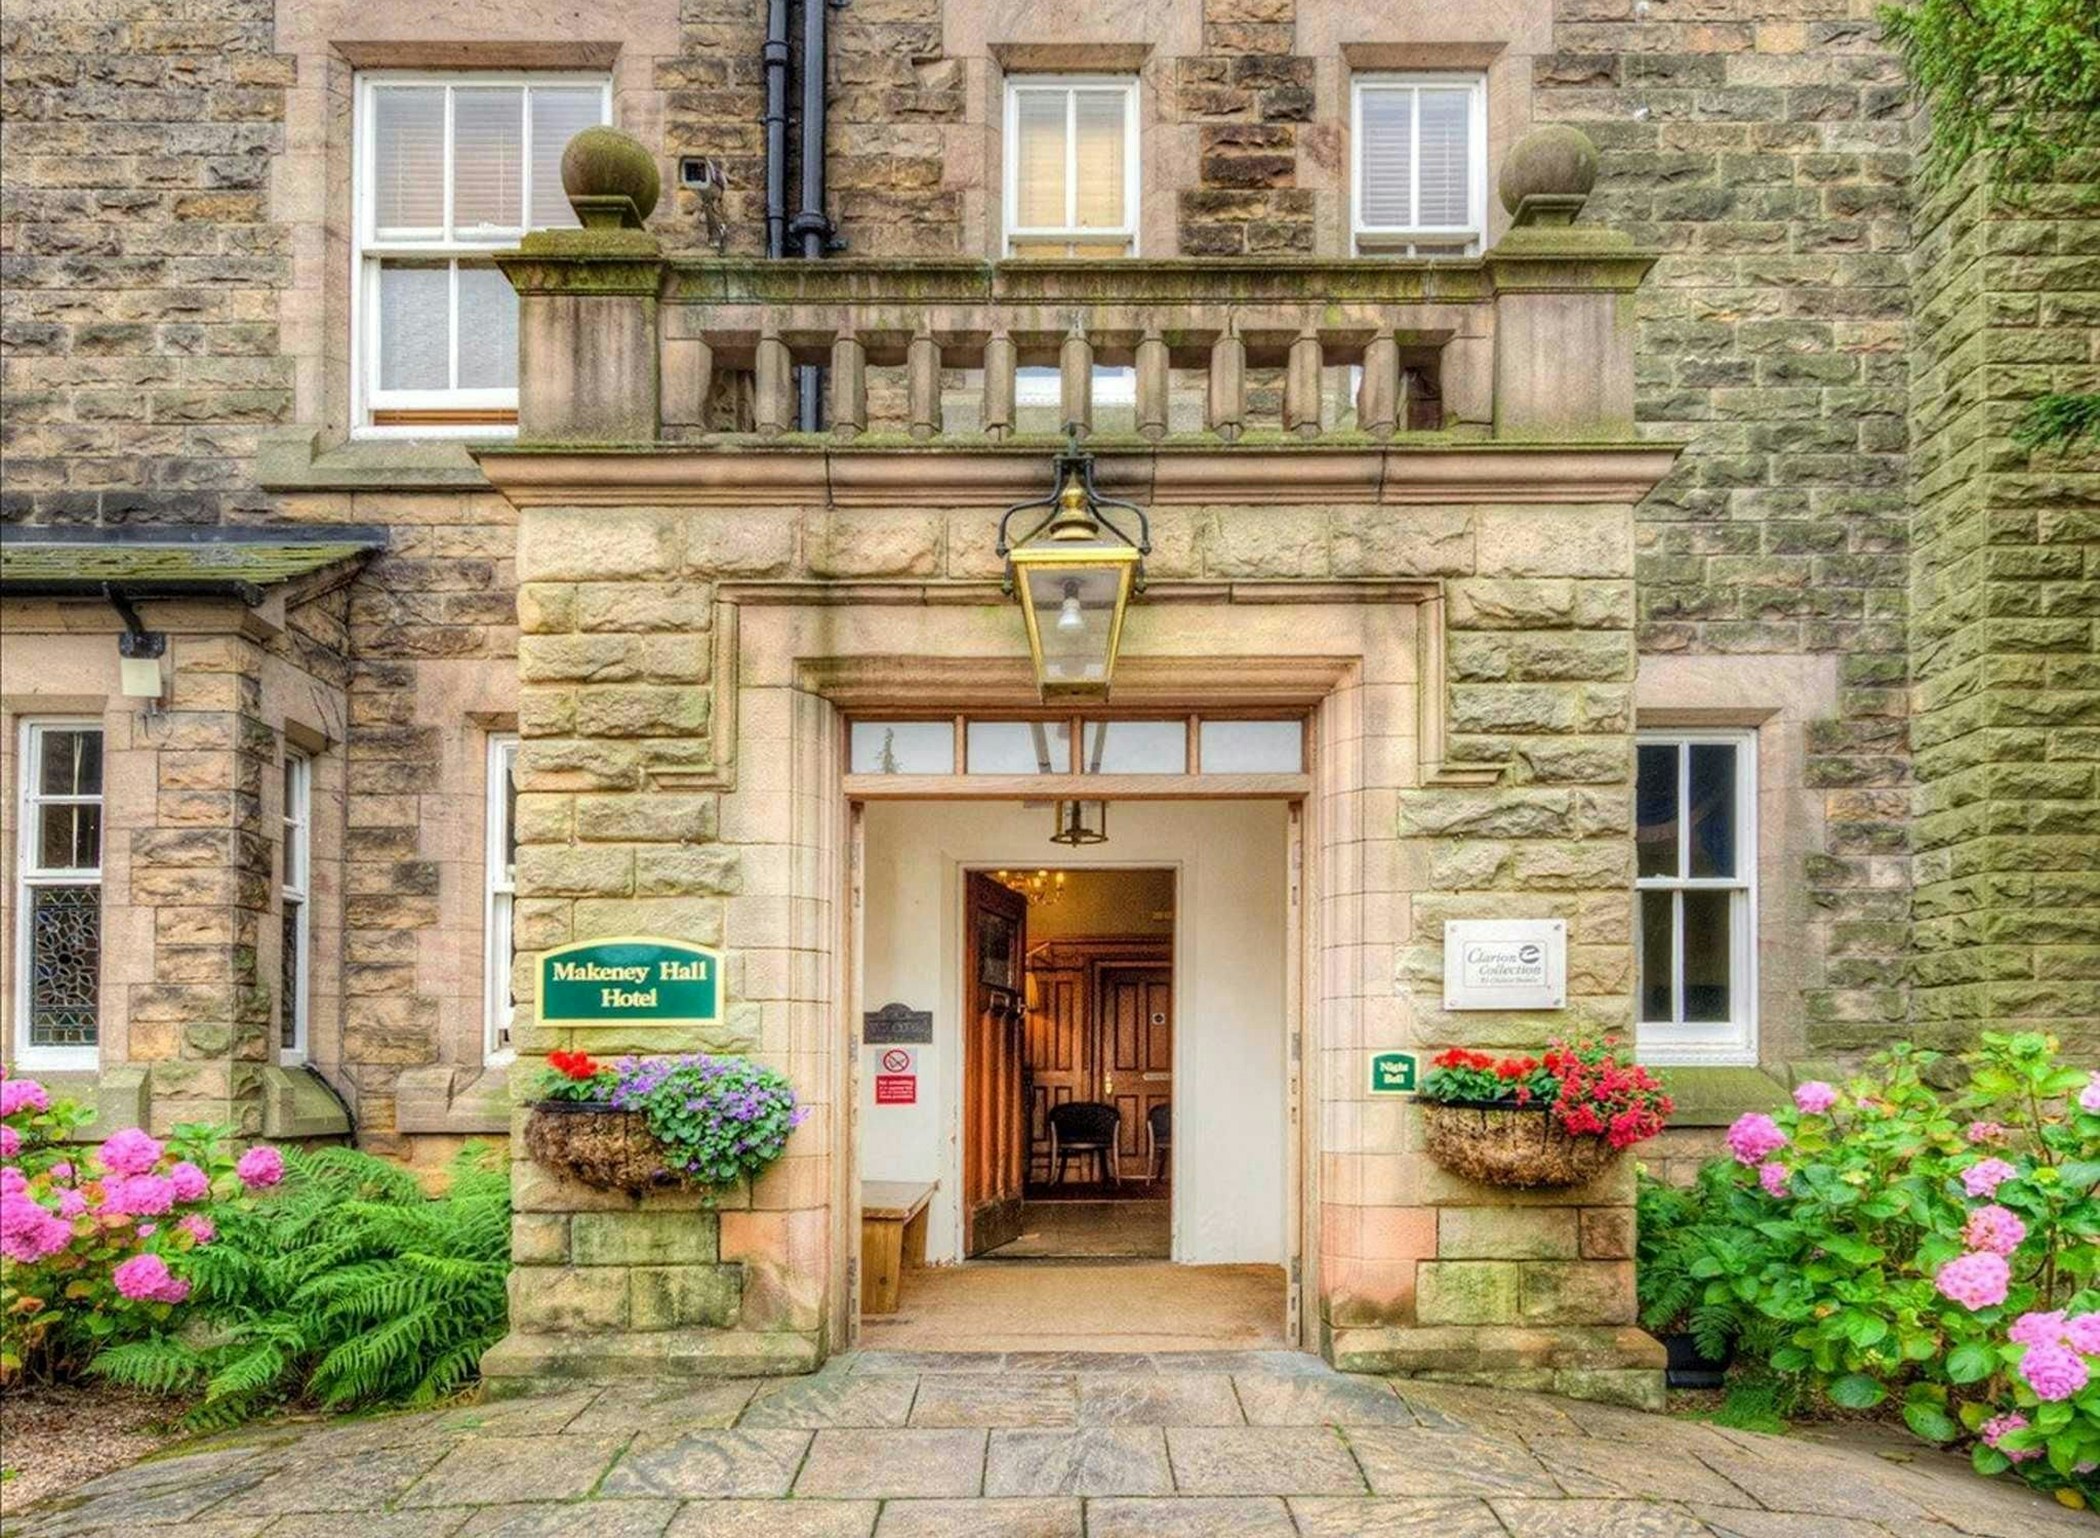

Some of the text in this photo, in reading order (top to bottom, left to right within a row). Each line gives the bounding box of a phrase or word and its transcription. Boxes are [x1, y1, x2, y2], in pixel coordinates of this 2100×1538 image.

[1468, 947, 1517, 964] Clarion
[552, 961, 707, 984] Makeney Hall
[1479, 964, 1541, 976] Collection
[601, 988, 658, 1008] Hotel
